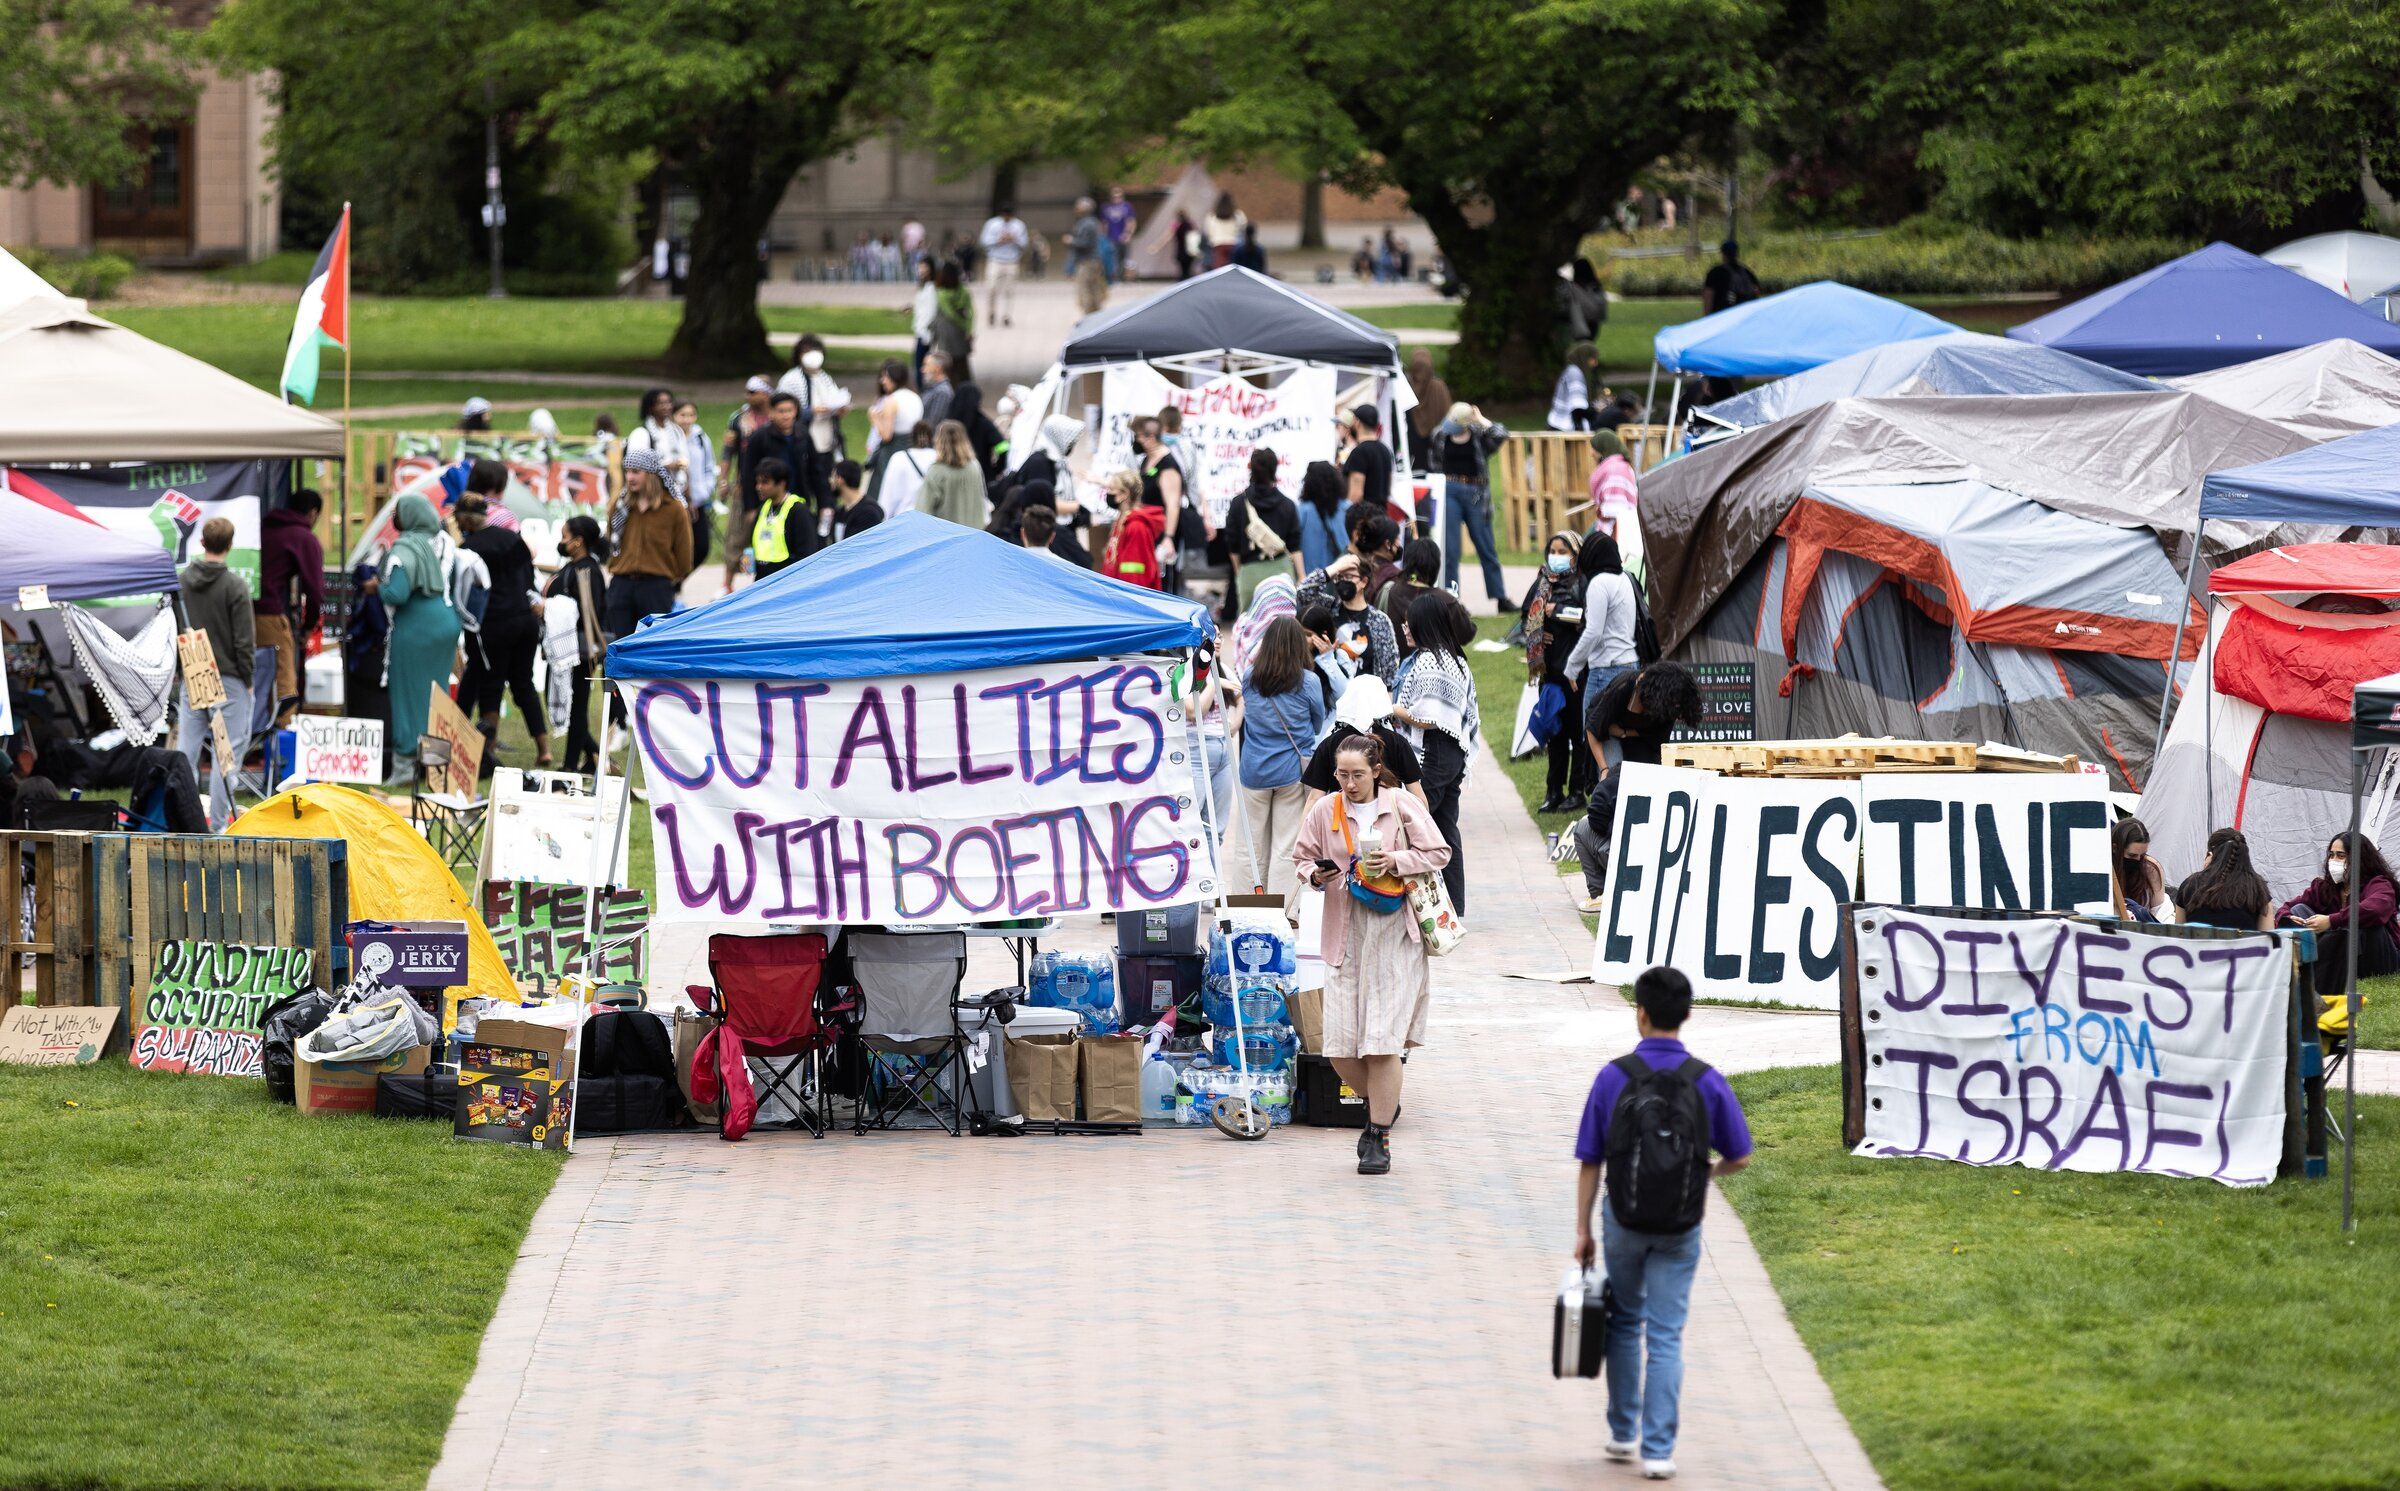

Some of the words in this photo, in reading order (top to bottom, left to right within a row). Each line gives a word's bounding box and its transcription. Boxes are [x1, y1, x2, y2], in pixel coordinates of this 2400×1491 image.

[127, 463, 207, 491] FREE
[1716, 676, 1751, 684] MATTER
[1716, 702, 1751, 713] LOVE
[301, 718, 333, 750] Stop
[335, 717, 380, 760] Funding
[635, 678, 831, 790] CUT
[831, 682, 1013, 792] ALL
[979, 664, 1164, 786] TIES
[1669, 730, 1682, 740] EE
[1687, 730, 1752, 740] PALESTINE
[655, 802, 871, 921] WITH
[883, 795, 1191, 919] BOEING
[483, 879, 649, 934] FREE
[397, 951, 462, 966] JERKY
[405, 944, 455, 952] DUCK
[1881, 920, 2270, 1034] DIVEST
[12, 1014, 48, 1035] Not
[54, 1015, 79, 1032] With
[80, 1016, 103, 1034] My
[146, 988, 289, 1028] OCCUPAT
[41, 1031, 86, 1047] TAXES
[137, 1027, 265, 1075] SOLIDARITY
[2004, 1002, 2162, 1078] FROM
[534, 1127, 544, 1136] 54
[1876, 1047, 2268, 1184] ISRAEL
